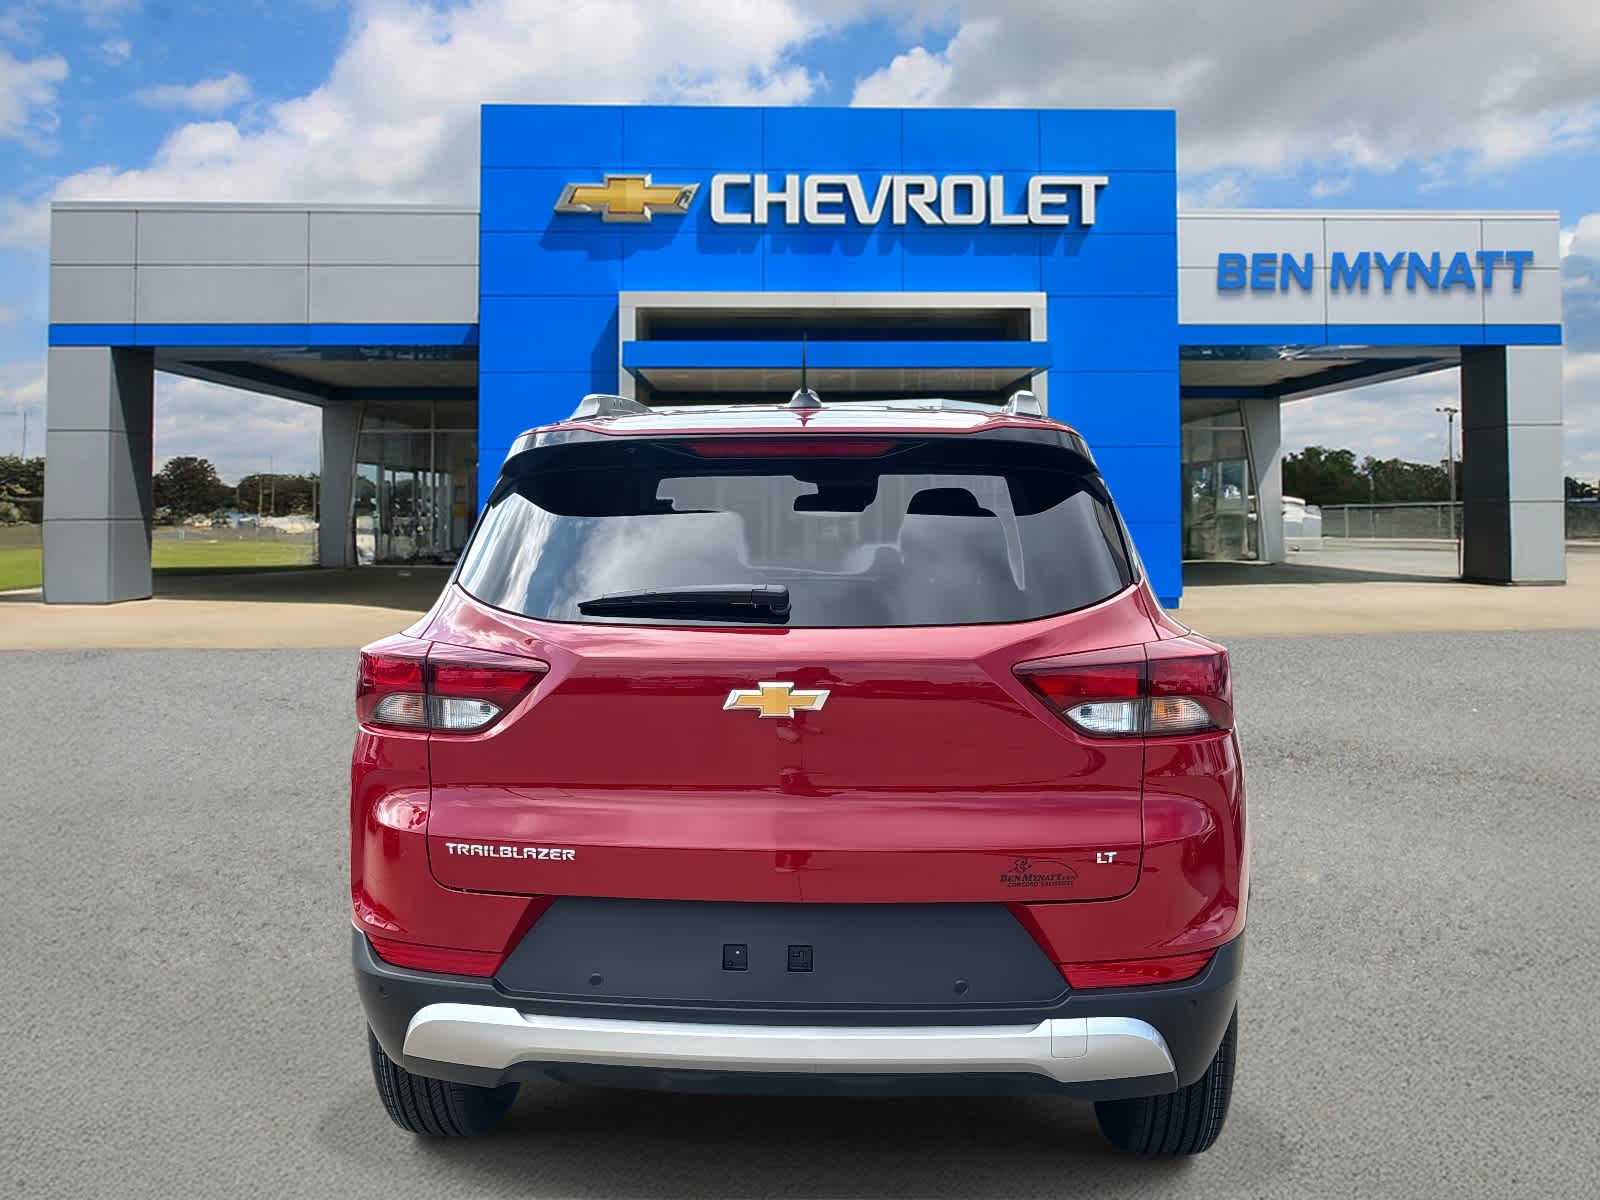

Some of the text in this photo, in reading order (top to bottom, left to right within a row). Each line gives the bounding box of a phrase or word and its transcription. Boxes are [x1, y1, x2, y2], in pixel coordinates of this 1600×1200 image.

[710, 173, 1110, 225] CHEVROLET
[1217, 250, 1535, 291] BEN MYNATT
[445, 842, 576, 861] TRAILBLAZER
[1096, 851, 1118, 864] LT
